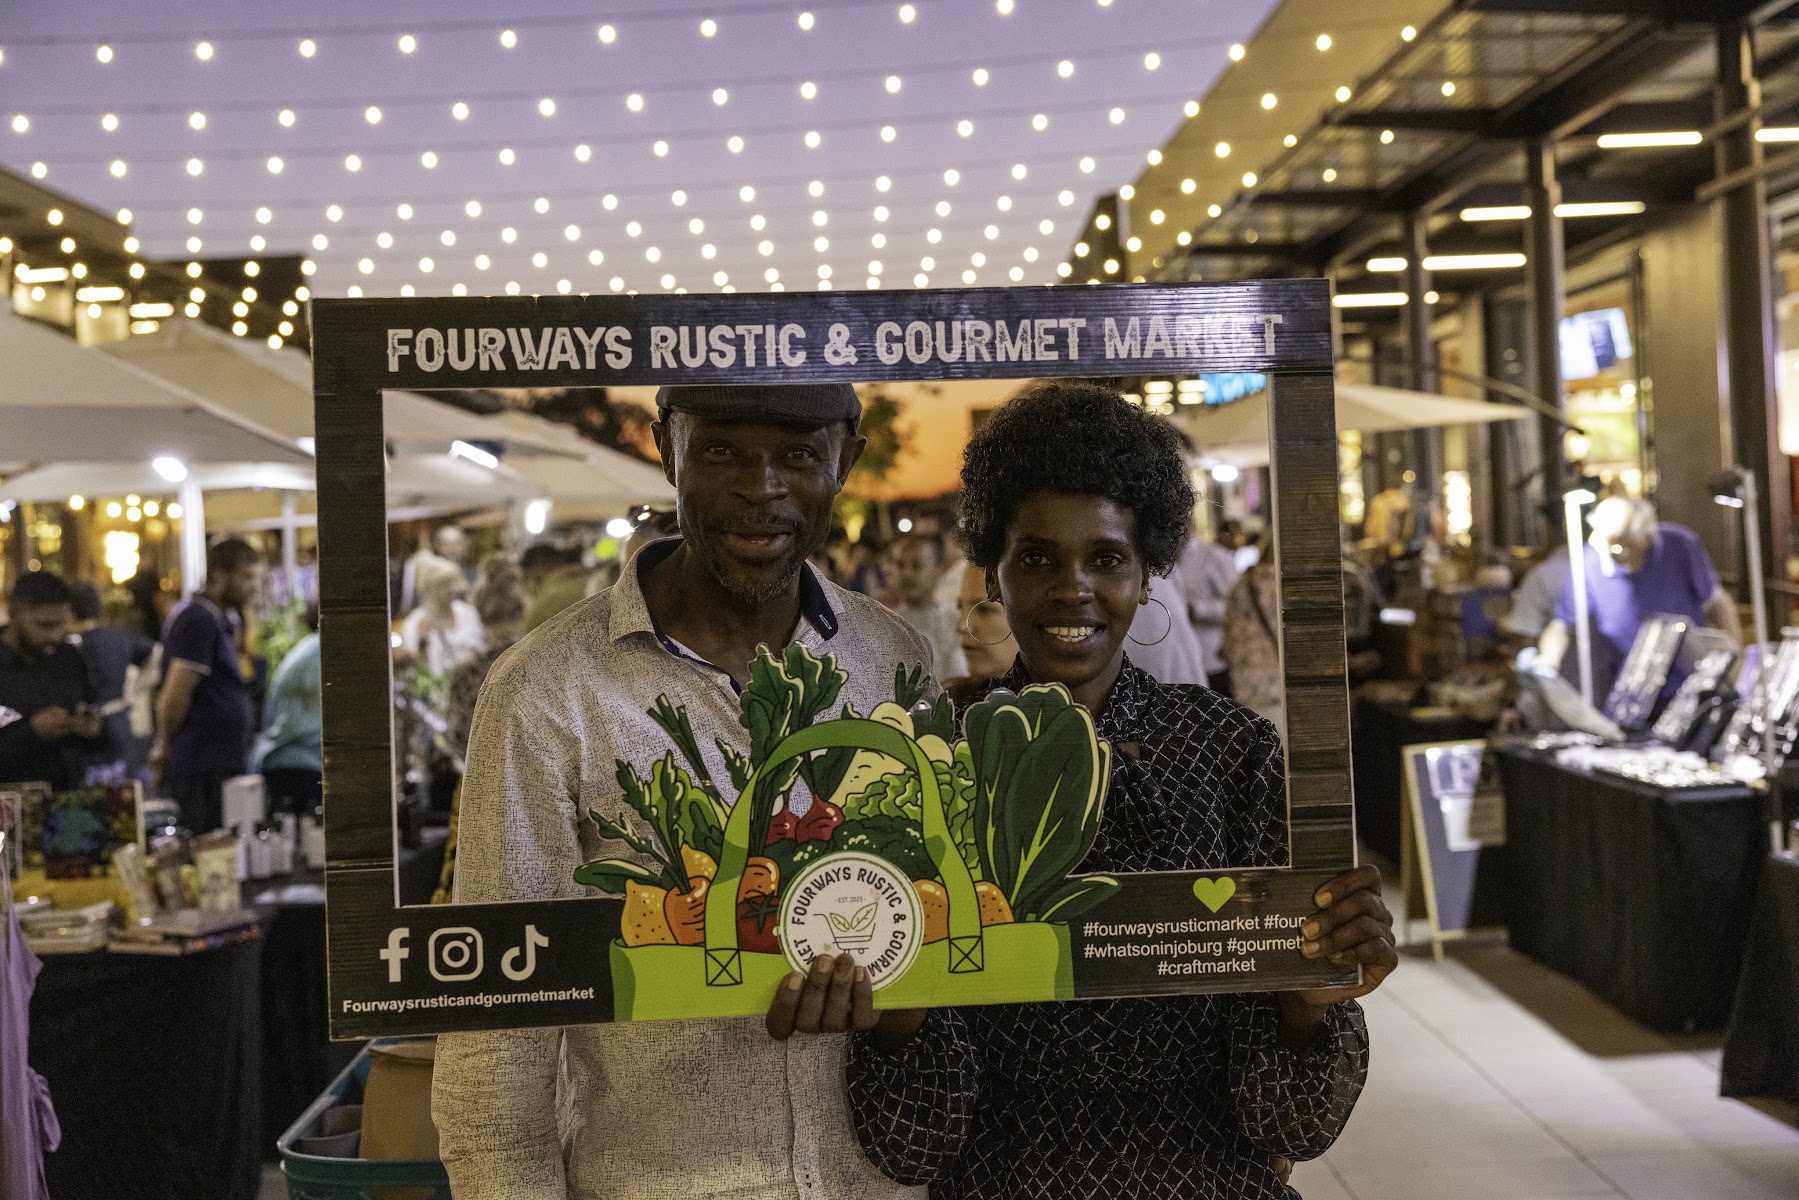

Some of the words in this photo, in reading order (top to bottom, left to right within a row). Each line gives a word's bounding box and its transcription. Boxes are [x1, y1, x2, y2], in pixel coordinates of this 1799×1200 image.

[387, 326, 633, 372] FOURWAYS
[651, 323, 806, 369] RUSTIC
[824, 322, 858, 366] &
[875, 318, 1086, 365] GOURMET
[791, 866, 851, 926] FOURWAYS
[857, 867, 902, 908] RUSTIC
[893, 913, 906, 924] &
[1083, 916, 1261, 938] #fourwaysrusticmarket
[1264, 914, 1307, 930] #four
[793, 939, 817, 966] KET
[867, 930, 906, 977] GOURM
[1084, 940, 1223, 959] #whatsoninjoburg
[1227, 936, 1305, 955] #gourmet
[1158, 957, 1256, 976] #craftmarket
[342, 987, 595, 1013] Fourwaysrusticandgourmetmarket
